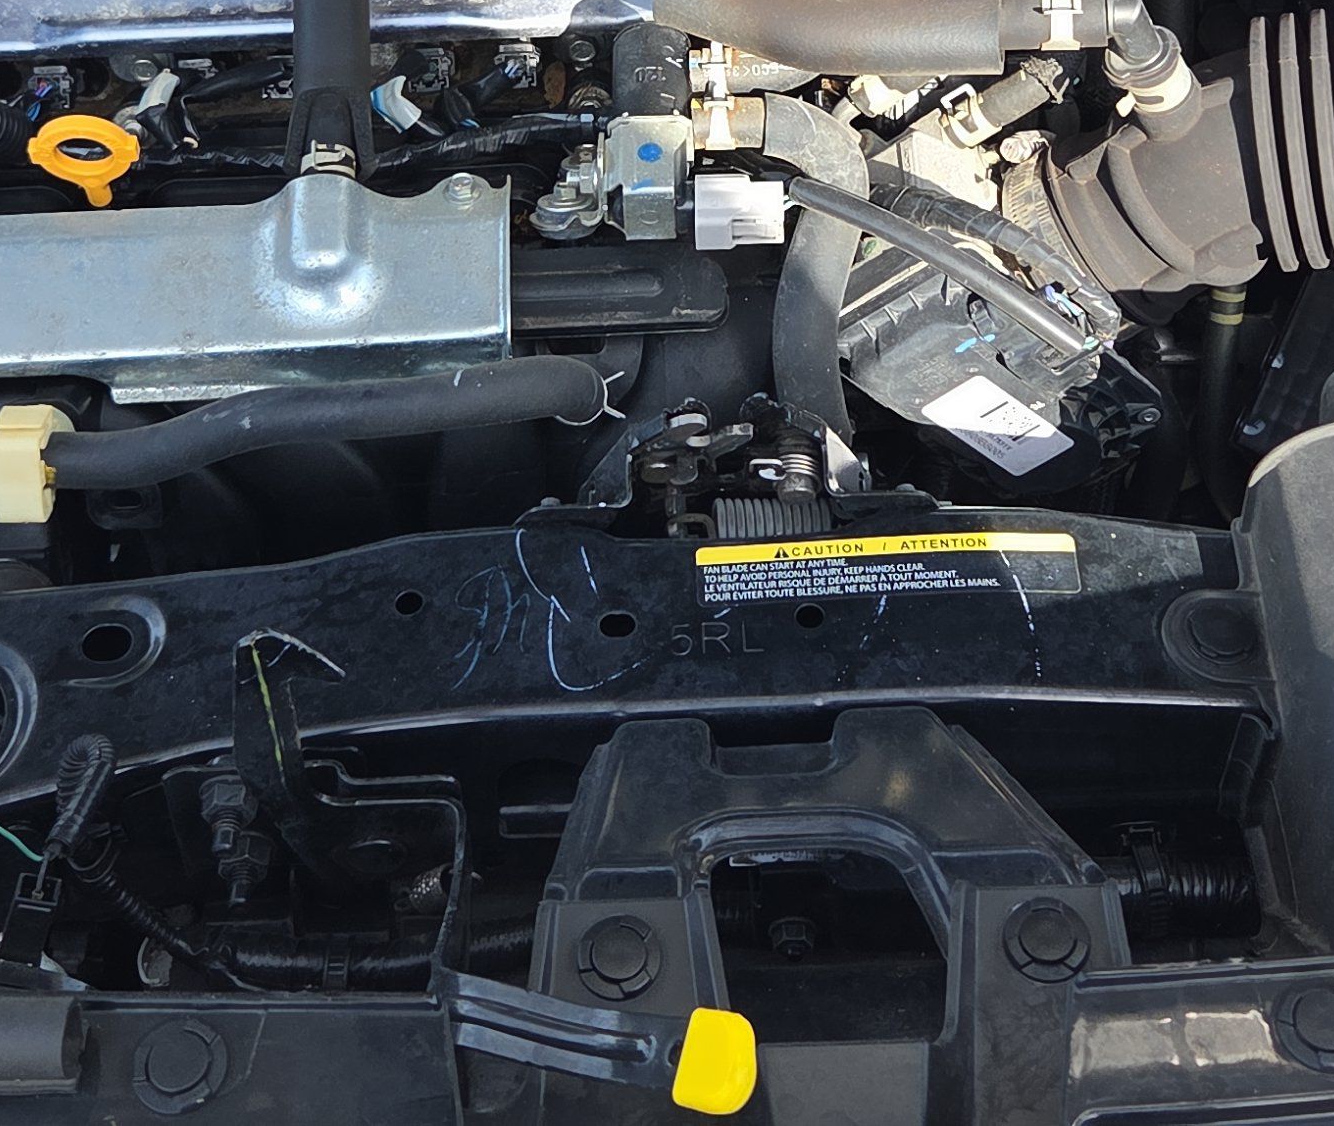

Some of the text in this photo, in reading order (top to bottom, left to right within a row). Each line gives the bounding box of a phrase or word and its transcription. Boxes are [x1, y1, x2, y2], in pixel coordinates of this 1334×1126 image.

[791, 542, 865, 557] CAUTION
[900, 537, 988, 551] ATTENTION
[703, 557, 848, 574] FAN BLADE CAN START AT ANY TIME.
[704, 575, 717, 583] TO
[717, 573, 739, 582] HELP
[739, 572, 767, 581] AVOID
[768, 569, 811, 579] PERSONAL
[843, 566, 865, 575] KEEP
[865, 564, 896, 573] HANDS
[896, 562, 926, 572] CLEAR.
[704, 584, 715, 593] LE
[716, 580, 777, 592] VENTILATEUR
[778, 578, 812, 588] RISQUE
[813, 577, 827, 586] DE
[827, 574, 878, 585] DÉMARRER
[888, 572, 913, 581] TOUT
[914, 569, 959, 580] MOMENT.
[704, 592, 732, 602] POUR
[732, 590, 764, 601] ÉVITER
[764, 588, 795, 598] TOUTE
[844, 585, 858, 593] NE
[859, 583, 877, 593] PAS
[877, 582, 892, 592] EN
[892, 580, 949, 591] APPROCHER
[949, 578, 967, 588] LES
[967, 578, 1001, 587] MAINS.
[671, 620, 765, 656] 5RL
